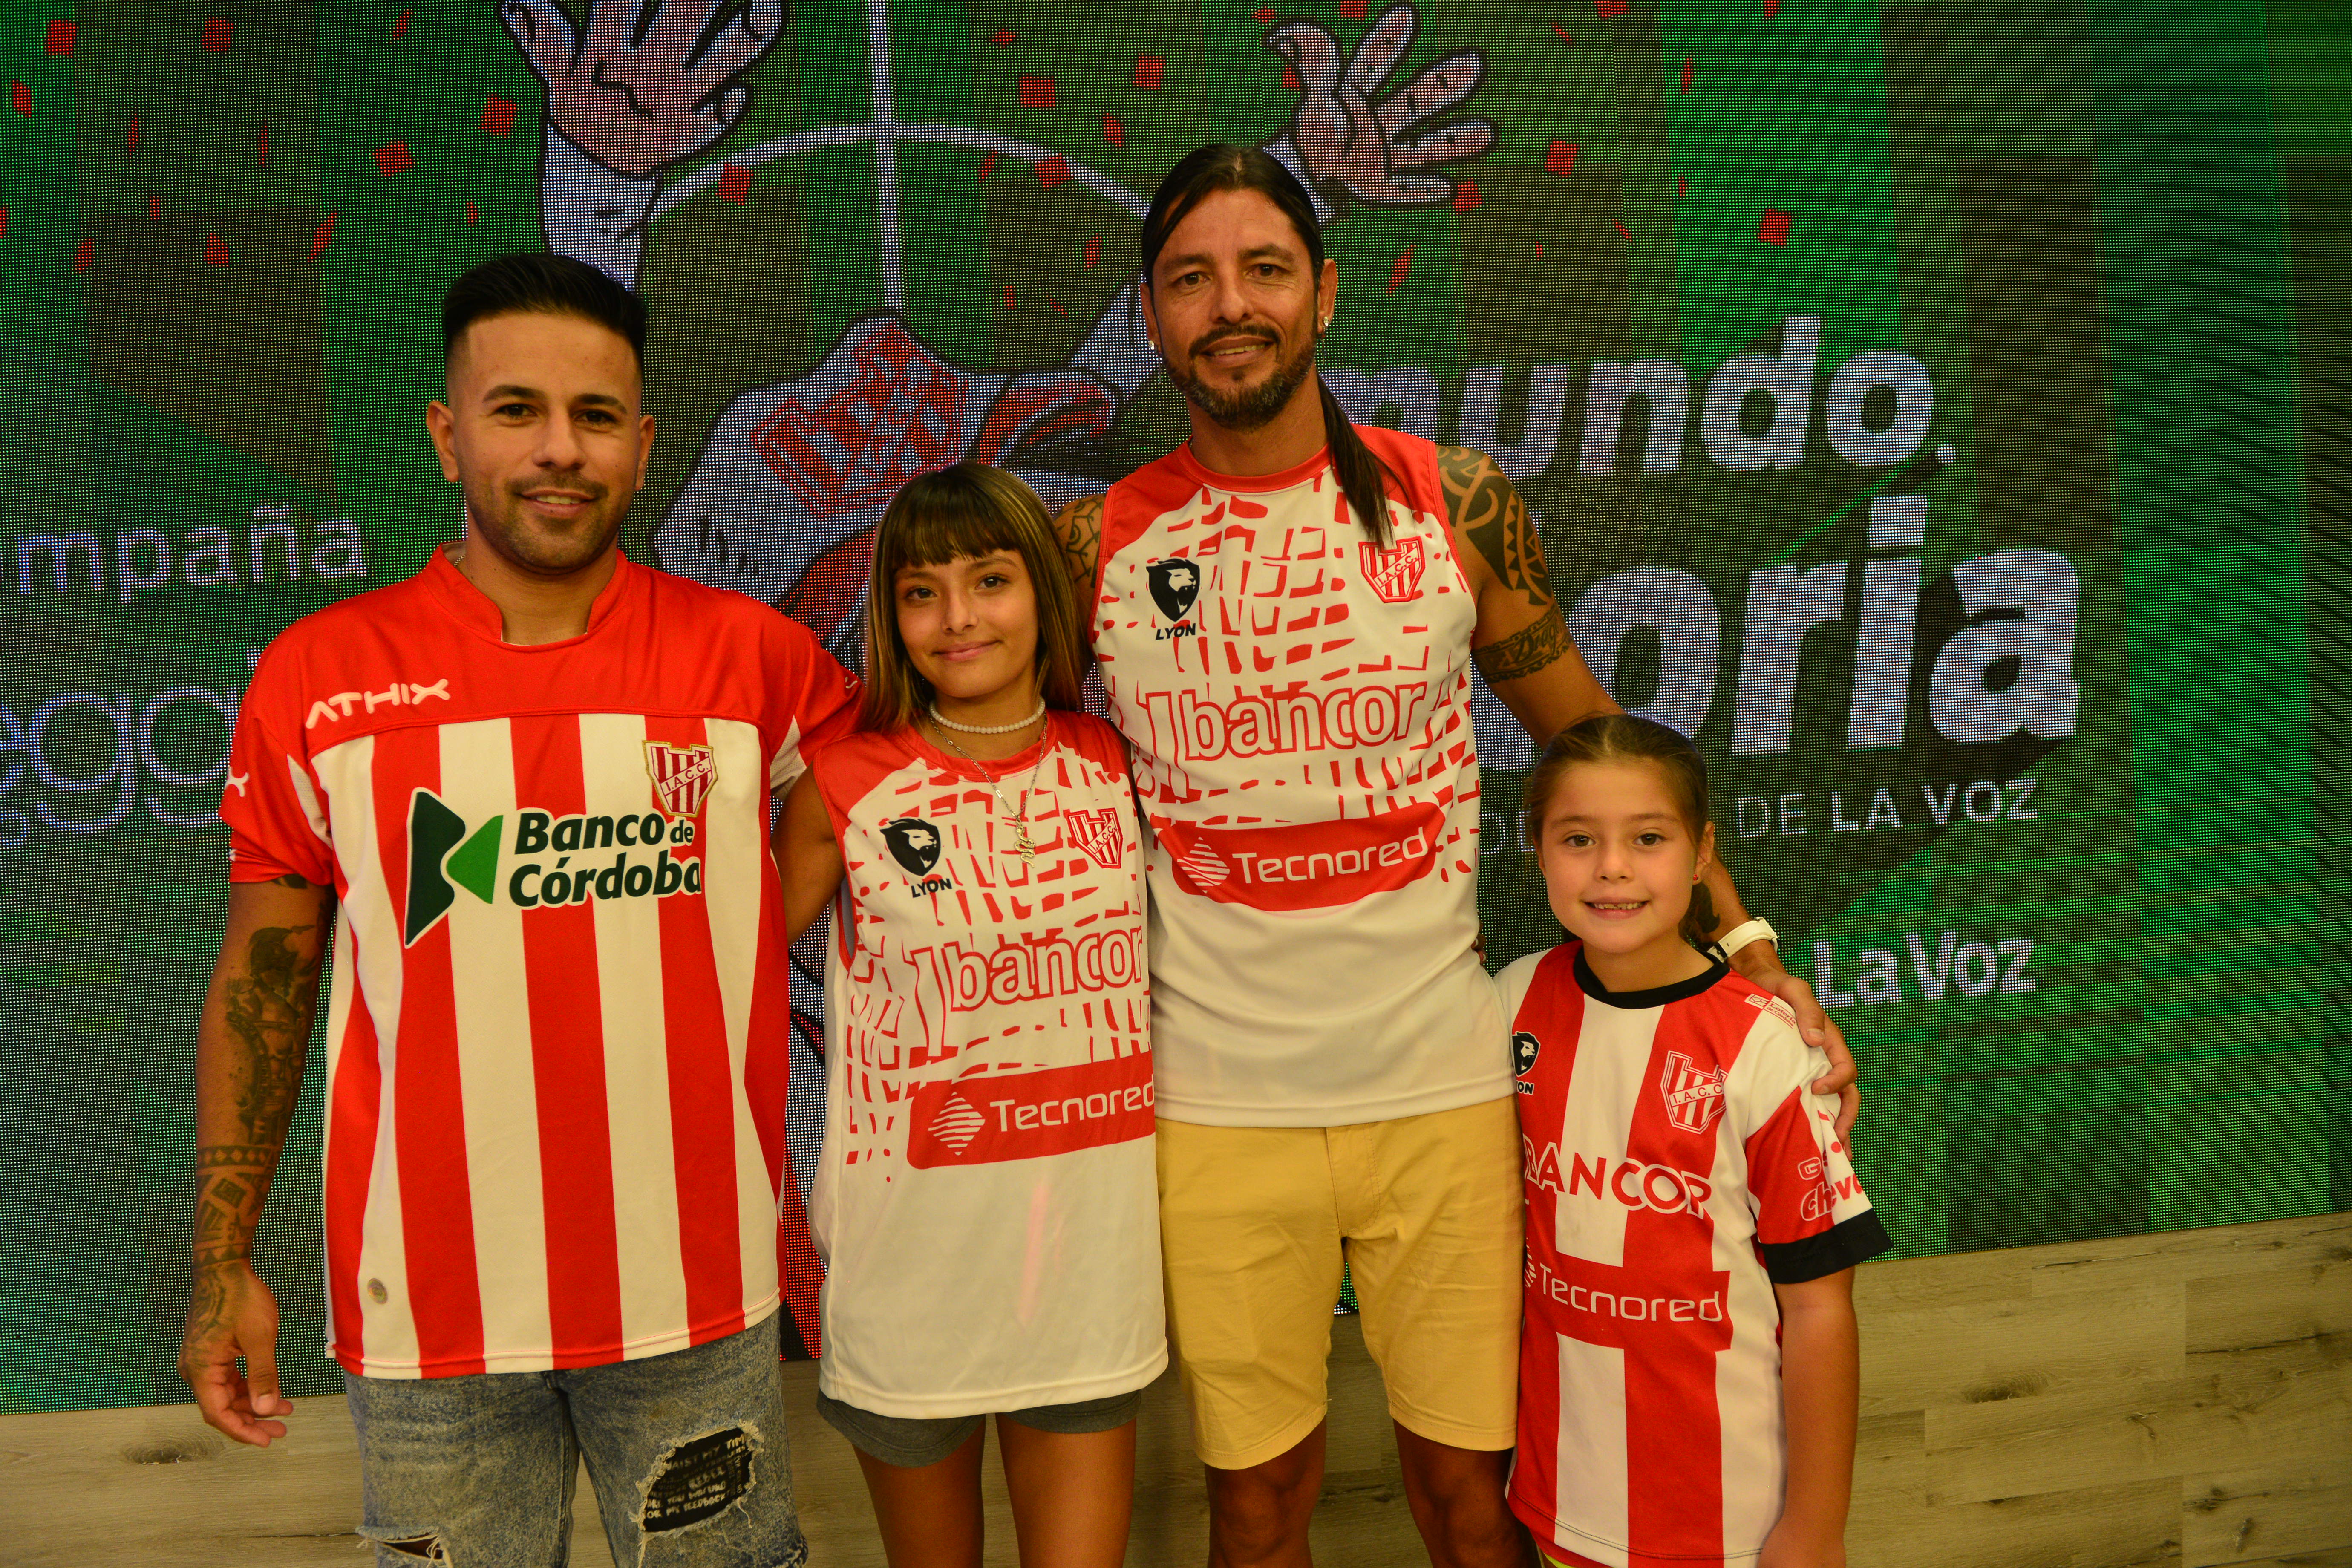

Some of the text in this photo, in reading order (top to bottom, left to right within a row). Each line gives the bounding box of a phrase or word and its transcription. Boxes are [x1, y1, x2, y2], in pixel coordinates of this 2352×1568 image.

[17, 502, 368, 604] mpaña
[1155, 623, 1196, 640] LYON
[1474, 495, 2080, 768] oria
[305, 678, 450, 729] ATHIX
[1181, 682, 1428, 762] bancor
[514, 812, 693, 855] Banco de
[1737, 778, 2038, 839] DE LA VOZ
[510, 849, 701, 907] Córdoba
[1231, 827, 1430, 884] Tecnored
[911, 878, 953, 898] LYON
[990, 1074, 1154, 1132] Tecnored
[1516, 1080, 1535, 1095] ON
[1539, 1262, 1722, 1323] Tecnored
